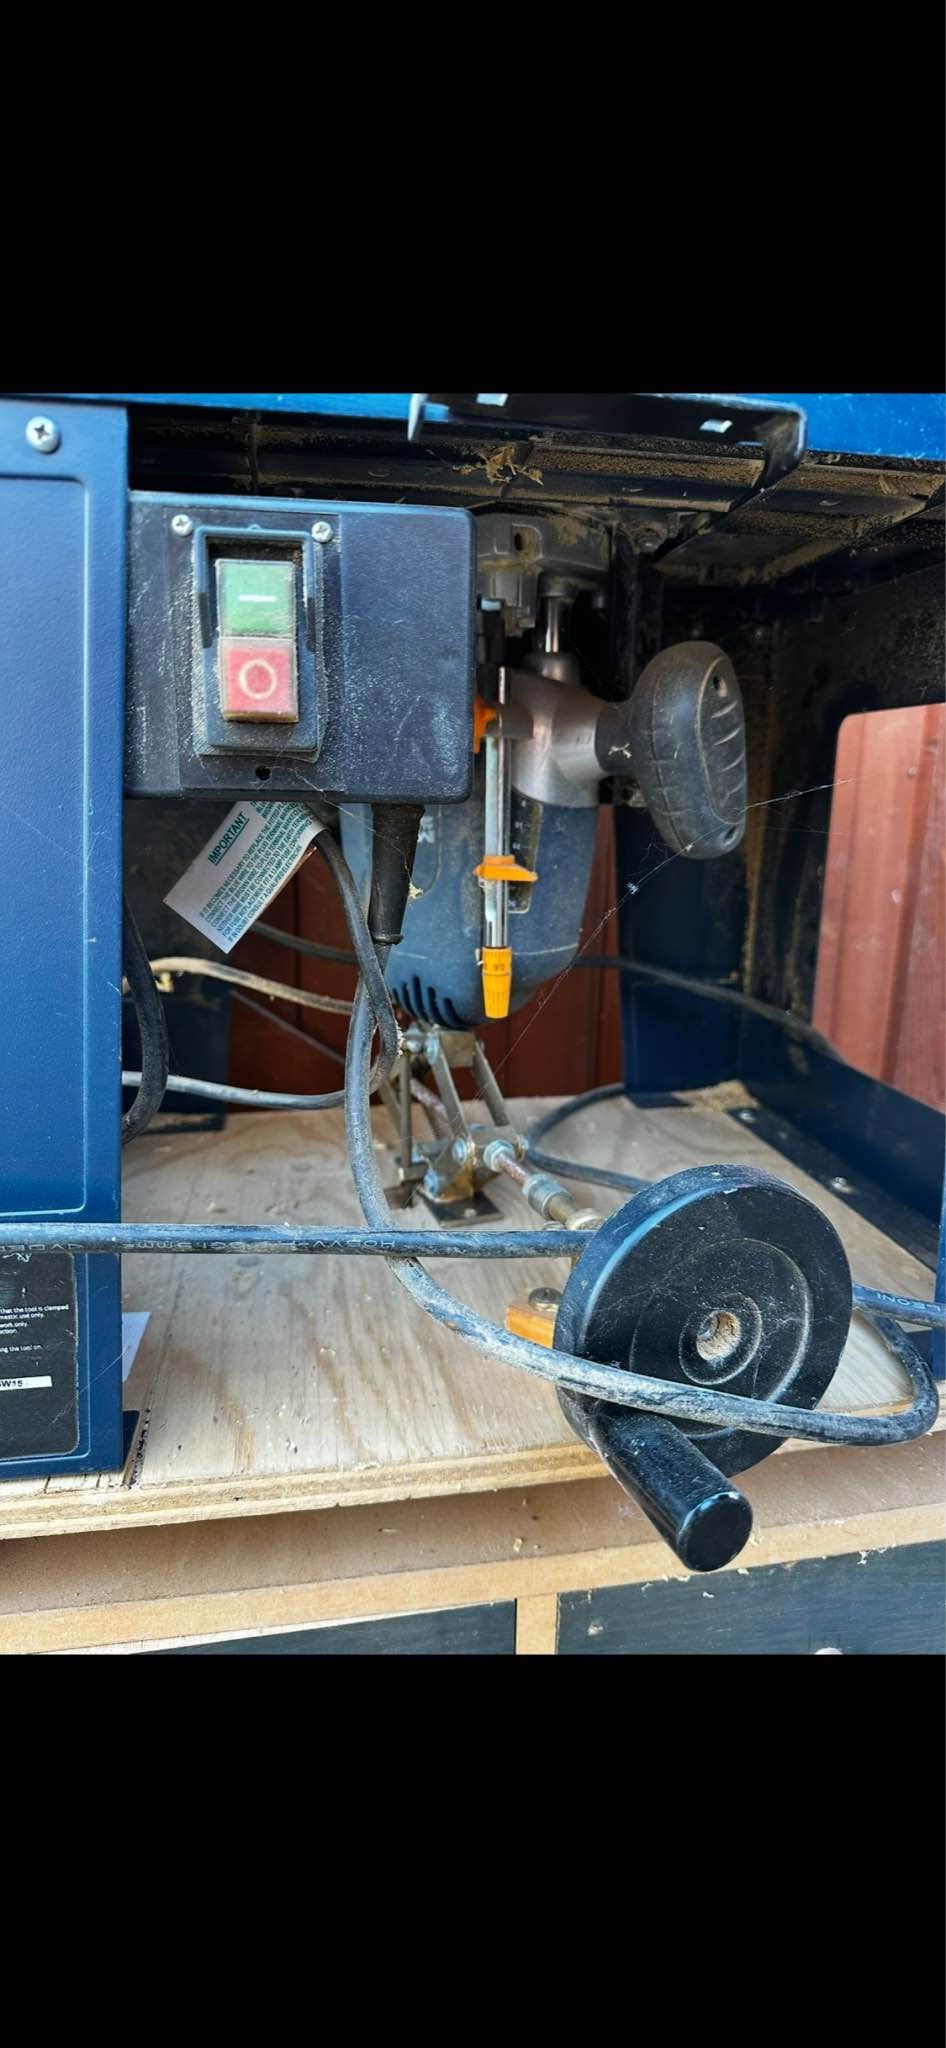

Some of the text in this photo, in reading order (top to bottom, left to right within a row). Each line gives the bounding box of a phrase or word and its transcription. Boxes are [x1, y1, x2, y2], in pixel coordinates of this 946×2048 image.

[207, 811, 250, 865] IMPORTANT
[43, 1304, 69, 1312] clamped
[876, 1292, 941, 1312] LEONI
